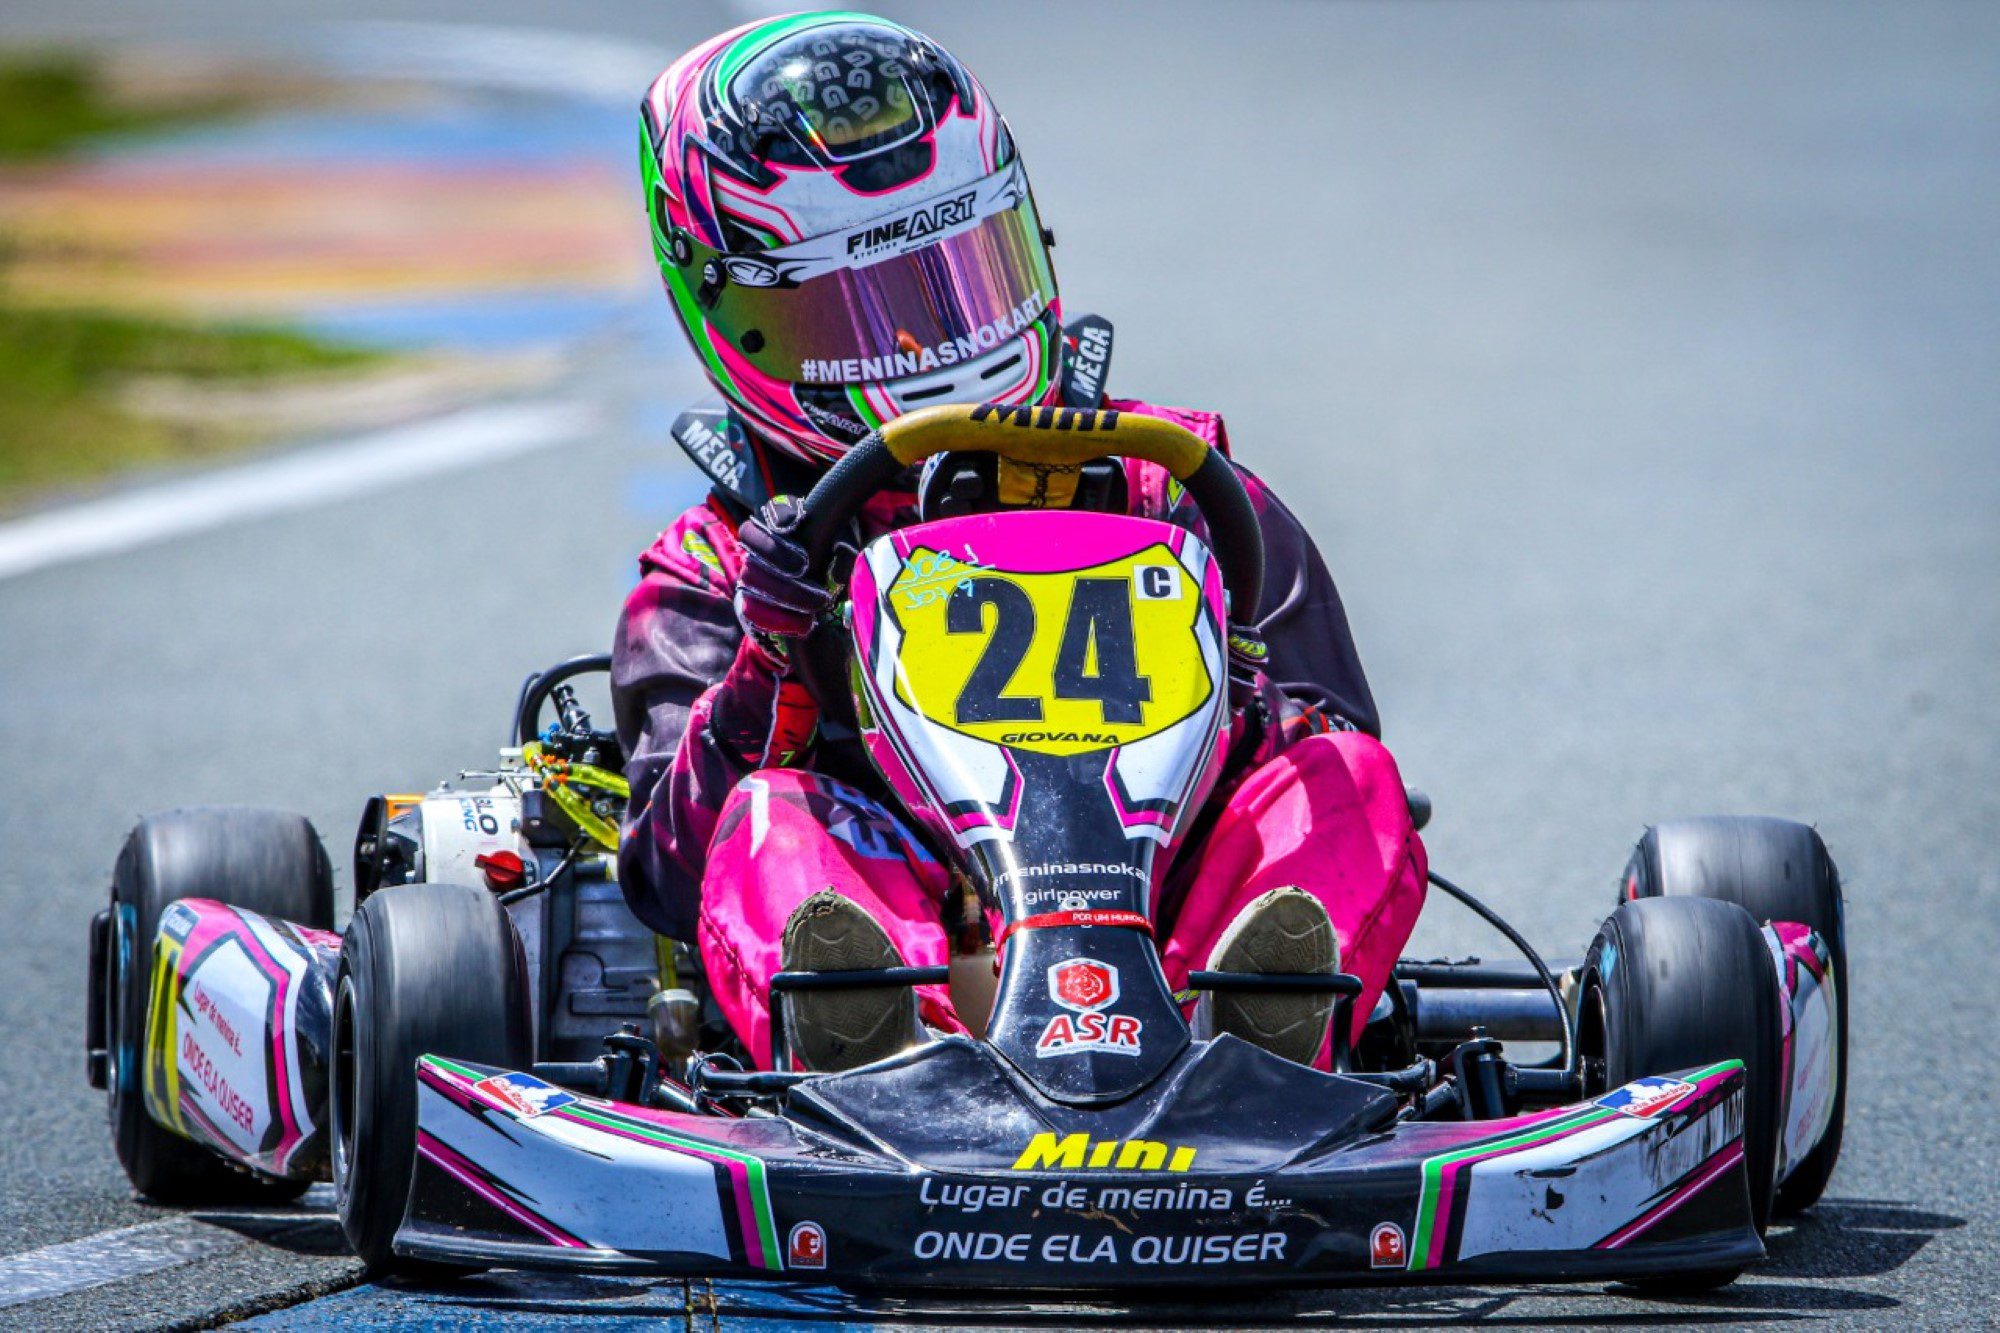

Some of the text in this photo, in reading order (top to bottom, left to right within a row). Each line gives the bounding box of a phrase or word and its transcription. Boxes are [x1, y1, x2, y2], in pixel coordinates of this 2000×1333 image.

[801, 290, 1044, 382] #MENINASNOKART
[1071, 326, 1110, 399] MEGA
[680, 419, 746, 491] MEGA
[1142, 566, 1171, 598] C
[946, 576, 1153, 725] 24
[1000, 732, 1120, 744] GIOVANA
[1038, 1011, 1141, 1049] ASR
[184, 1032, 254, 1136] ONDE ELA QUISER
[920, 1177, 1031, 1213] Lugar
[1041, 1181, 1088, 1208] de
[1098, 1182, 1233, 1209] menina
[914, 1230, 1287, 1264] ONDE ELA QUISER
